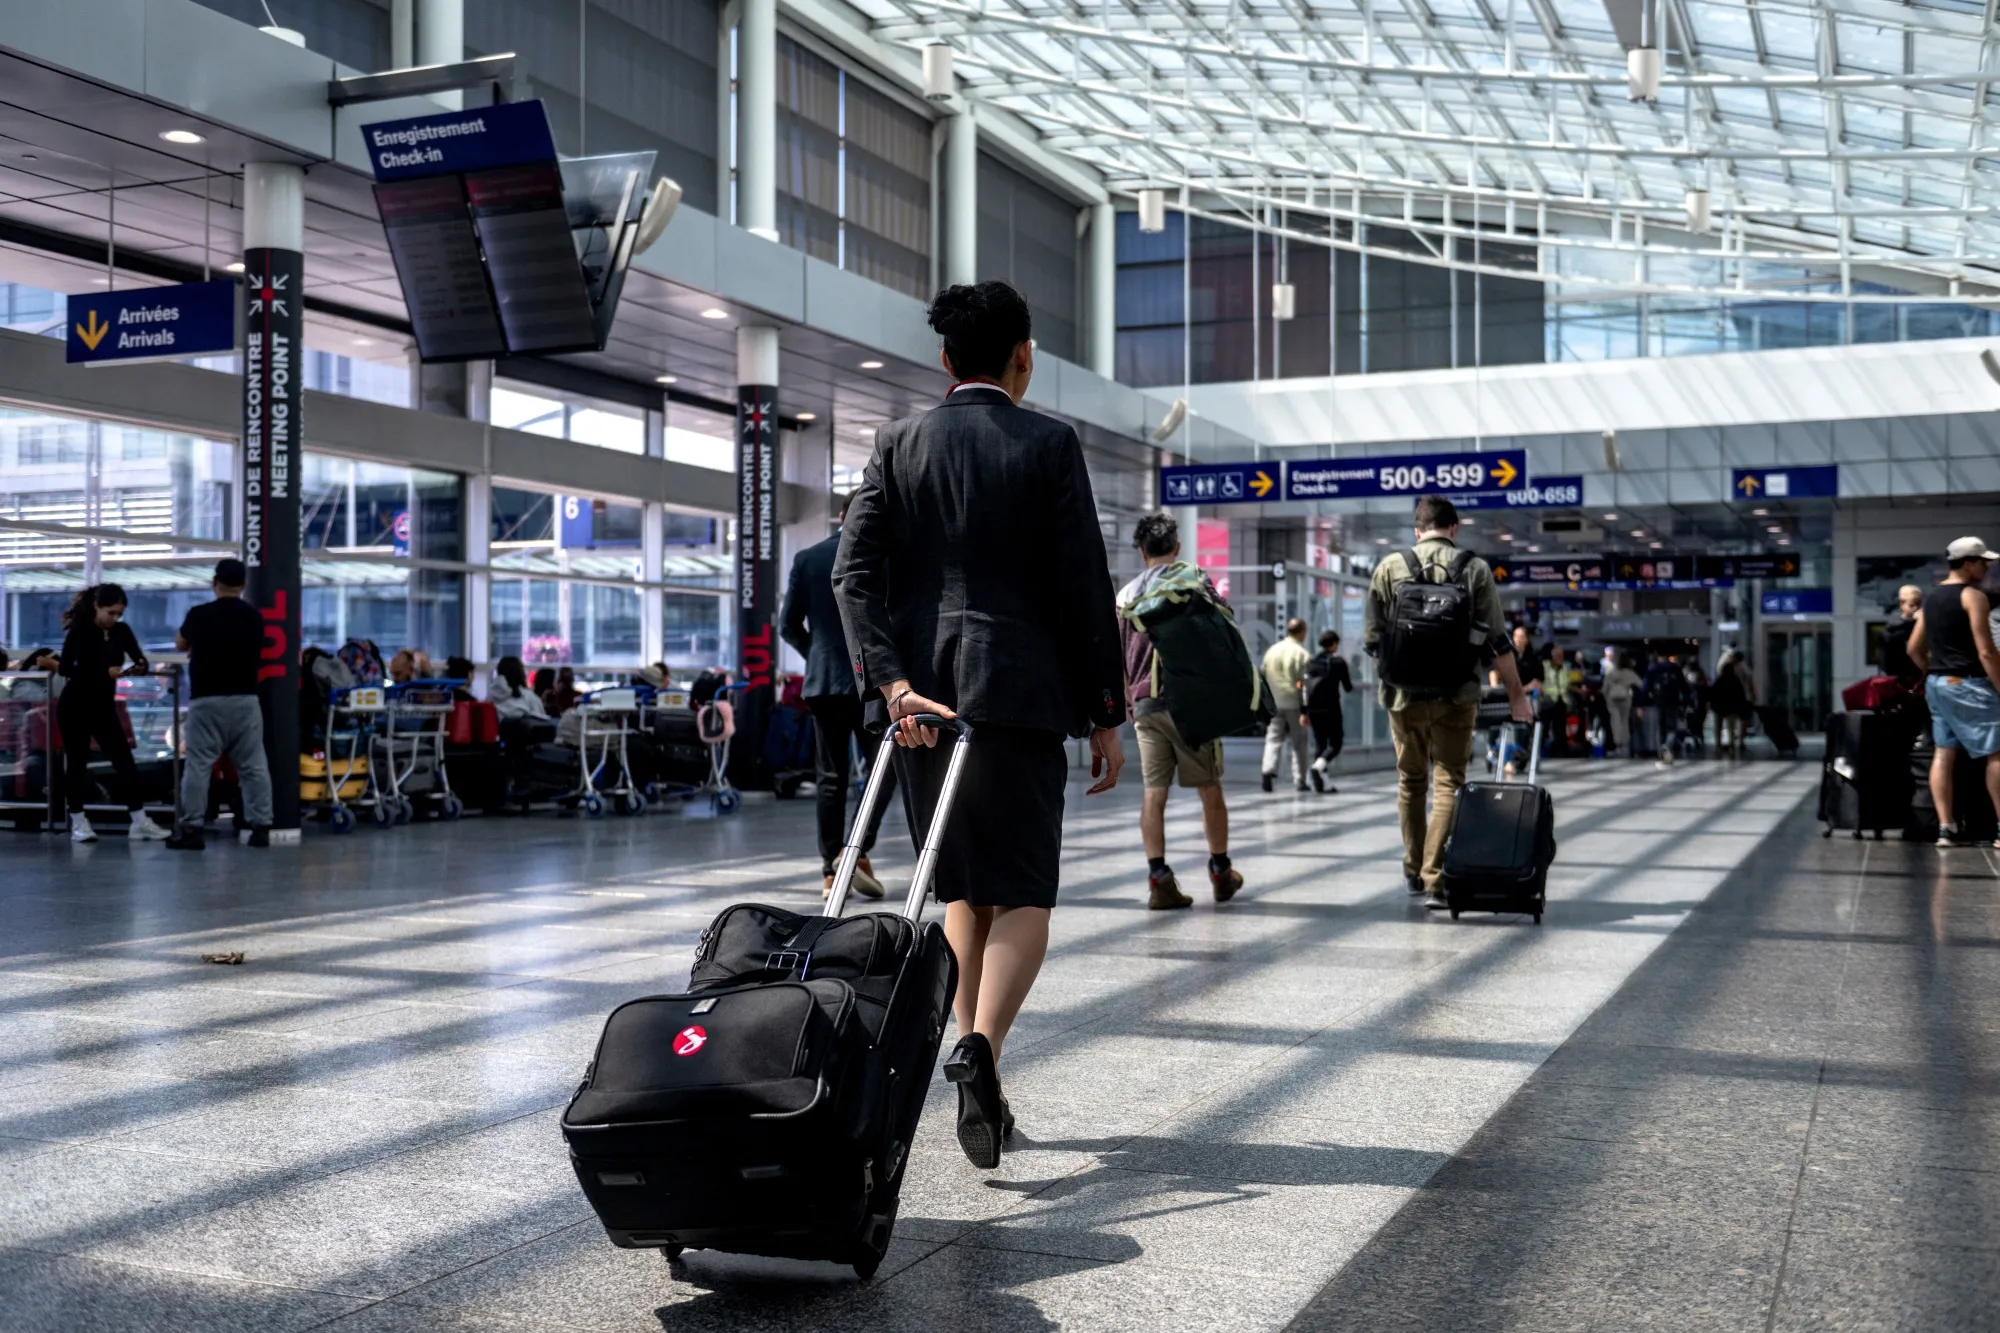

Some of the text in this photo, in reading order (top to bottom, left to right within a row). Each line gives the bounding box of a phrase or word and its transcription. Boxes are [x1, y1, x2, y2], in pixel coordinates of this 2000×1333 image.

[373, 118, 486, 147] Enregistrement
[379, 147, 443, 168] Check-in
[118, 304, 180, 325] Arrivées
[118, 328, 175, 349] Arrivals
[271, 333, 289, 498] MEETING POINT
[247, 332, 262, 567] POINT DE RENCONTRE
[1292, 469, 1375, 483] Enregistrement
[1379, 462, 1484, 491] 500-599
[1292, 482, 1339, 495] Check-in
[1506, 485, 1577, 505] 600-658
[565, 496, 579, 520] 6
[760, 443, 771, 560] MEETING POINT
[743, 443, 754, 609] POINT DE RENCONTRE
[1273, 562, 1284, 578] 6
